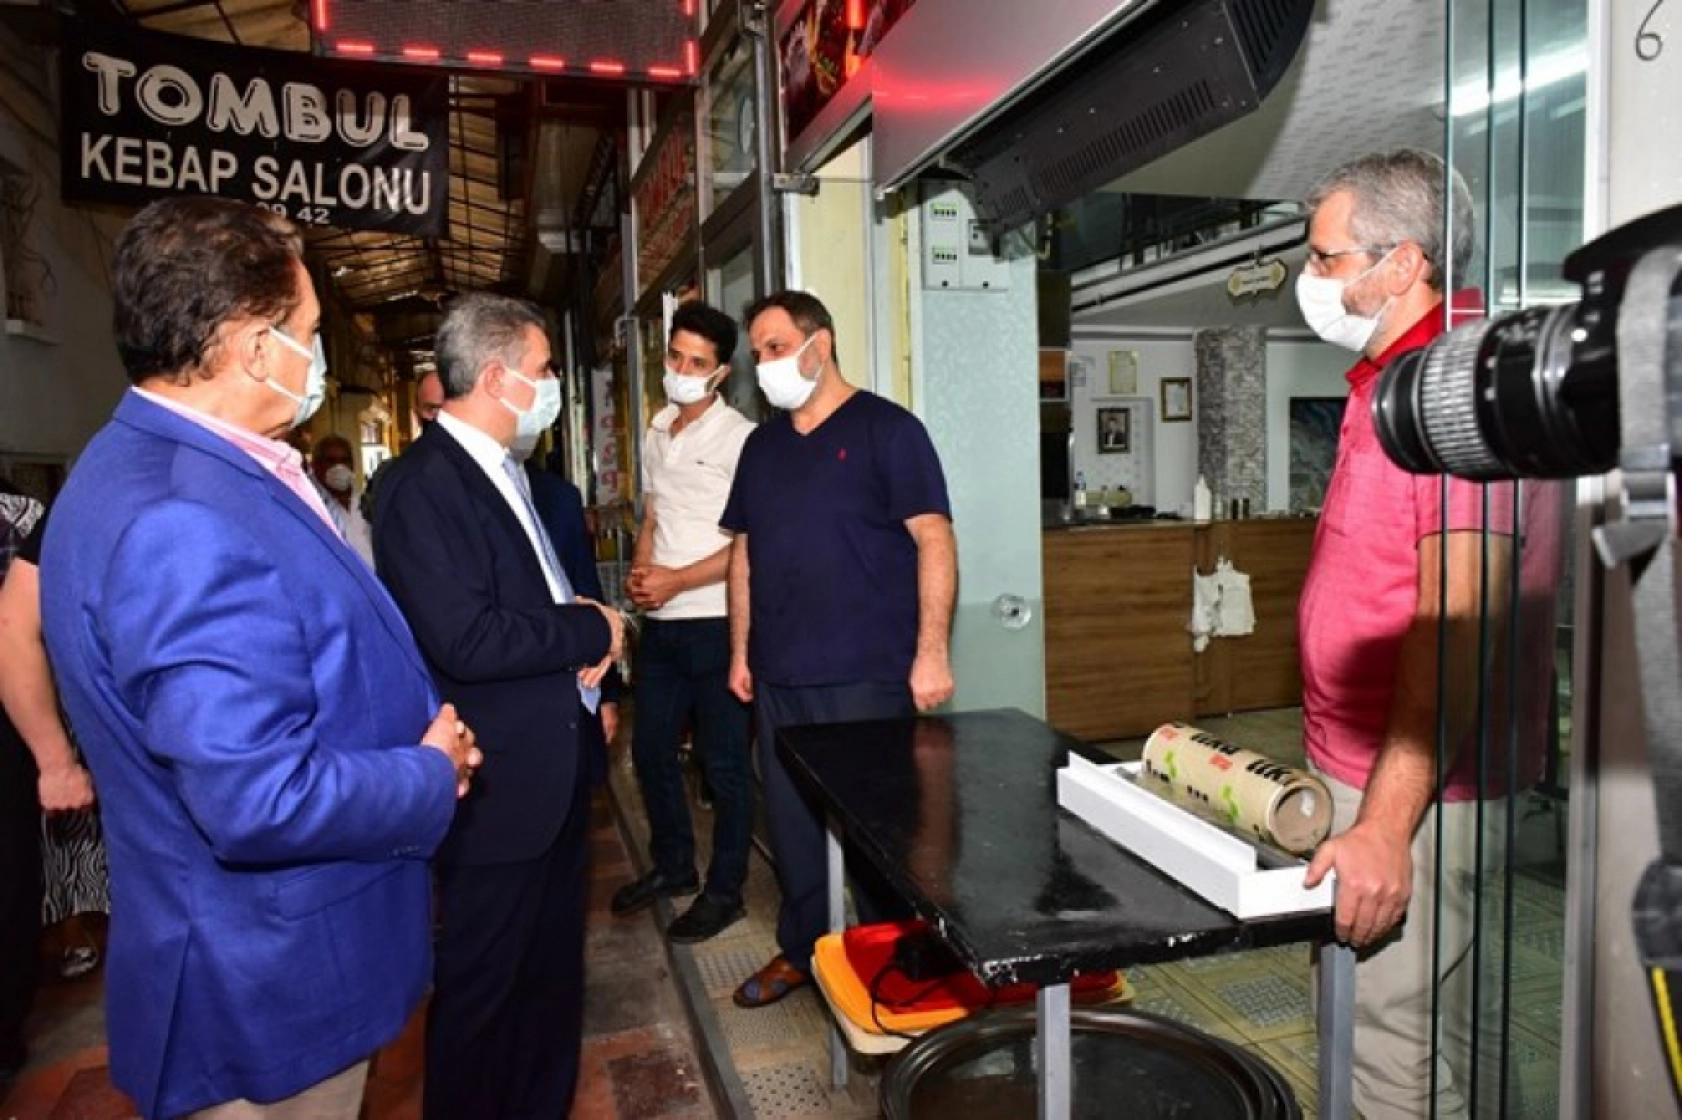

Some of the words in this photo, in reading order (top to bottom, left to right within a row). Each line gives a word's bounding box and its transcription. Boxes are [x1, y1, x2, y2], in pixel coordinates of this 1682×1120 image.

[82, 51, 430, 152] TOMBUL
[81, 132, 238, 194] KEBAP
[252, 155, 431, 215] SALONU
[296, 205, 331, 225] 42
